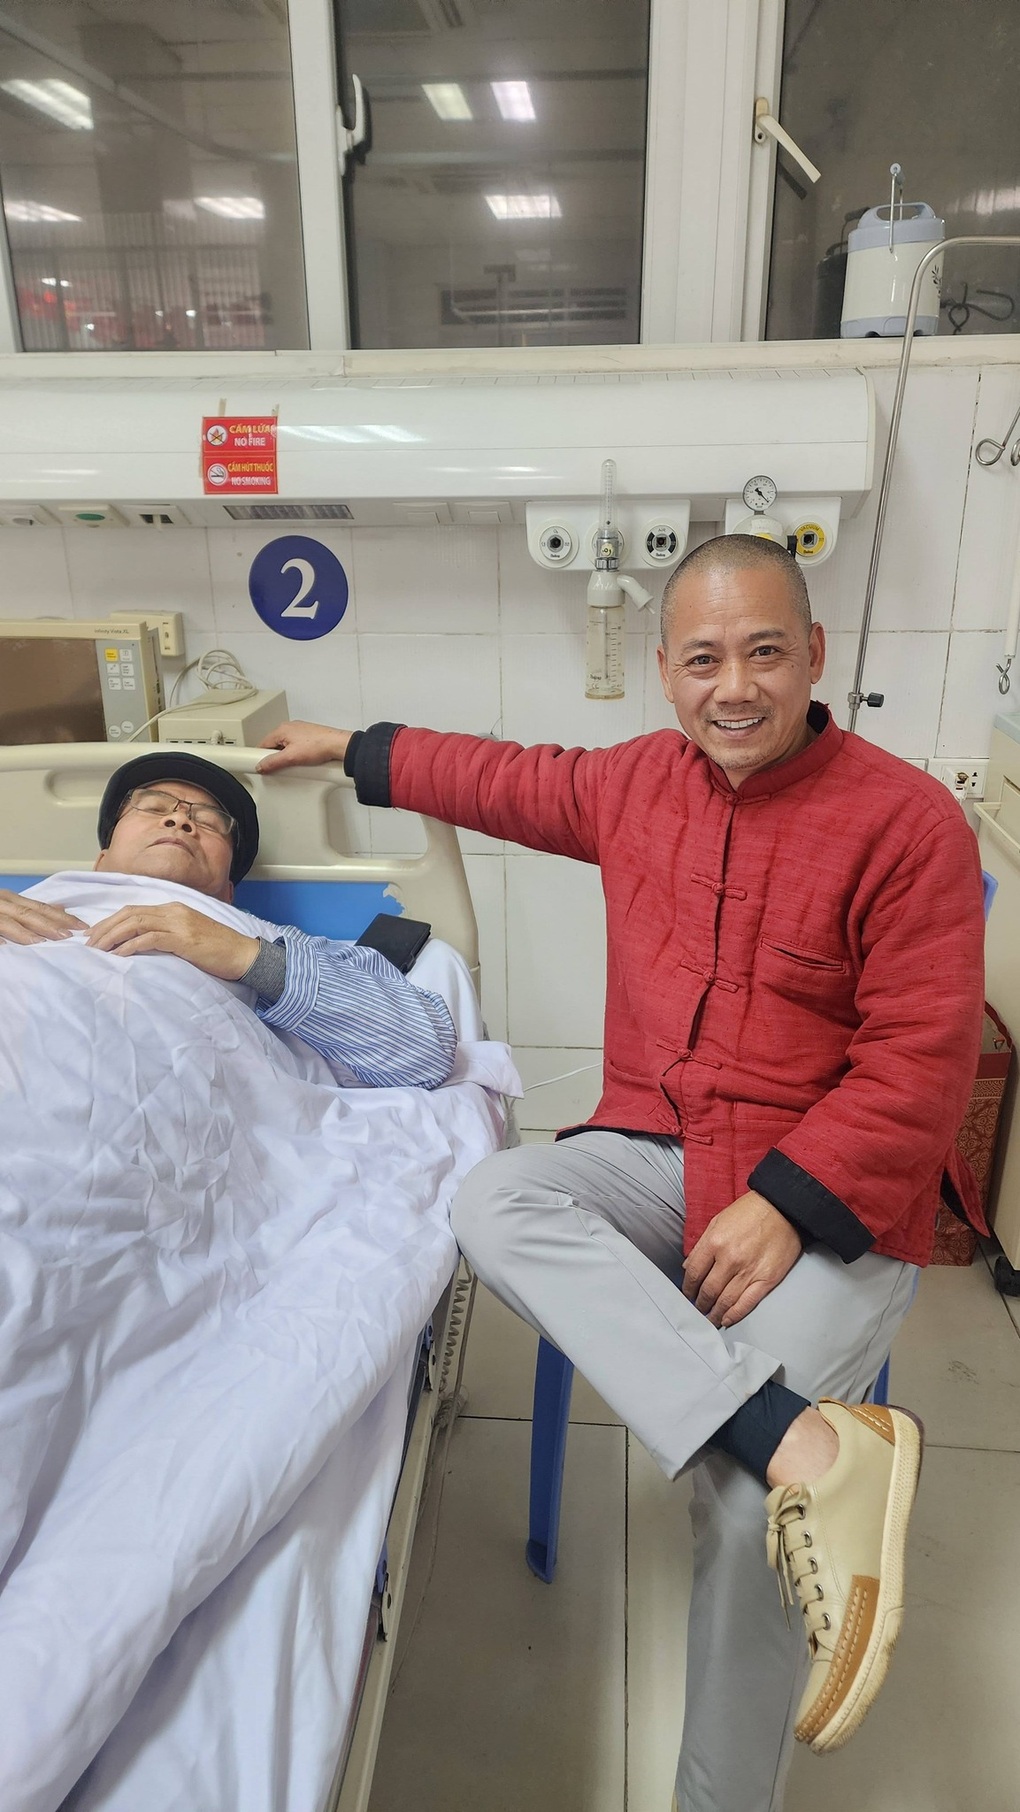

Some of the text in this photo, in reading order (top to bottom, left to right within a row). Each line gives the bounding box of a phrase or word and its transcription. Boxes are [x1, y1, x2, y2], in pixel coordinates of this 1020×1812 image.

[234, 437, 266, 447] NO FIRE
[231, 476, 271, 486] NO SMOKING
[280, 558, 319, 619] 2
